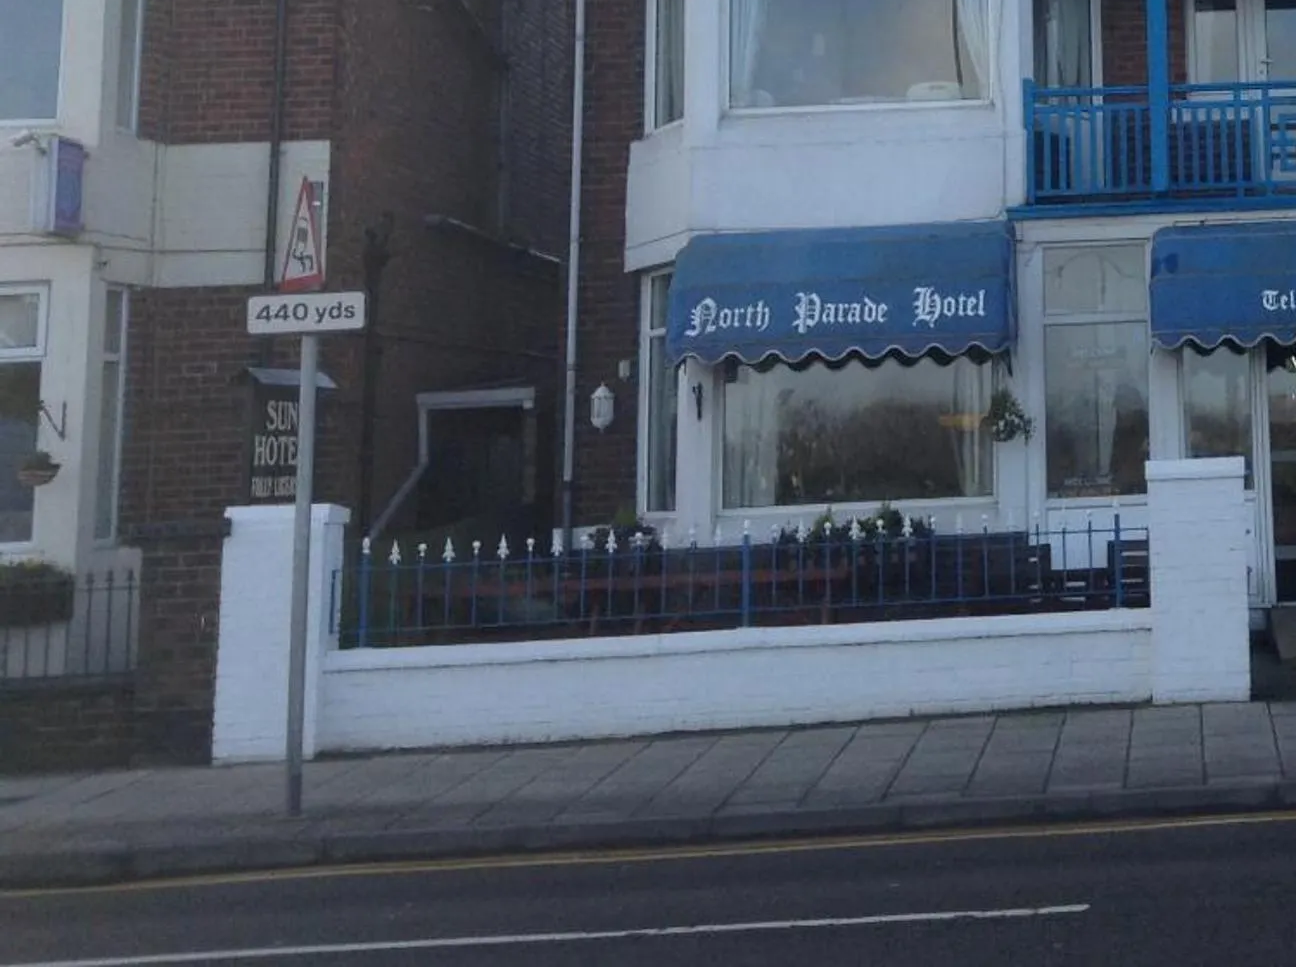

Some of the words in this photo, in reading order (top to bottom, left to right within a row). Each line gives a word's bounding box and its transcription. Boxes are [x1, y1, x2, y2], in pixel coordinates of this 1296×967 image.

[255, 303, 309, 322] 440
[315, 301, 356, 324] yds
[684, 296, 771, 337] North
[792, 292, 888, 333] Parade
[912, 285, 987, 328] Hotel
[266, 400, 299, 430] SUN
[253, 435, 299, 466] HOTE
